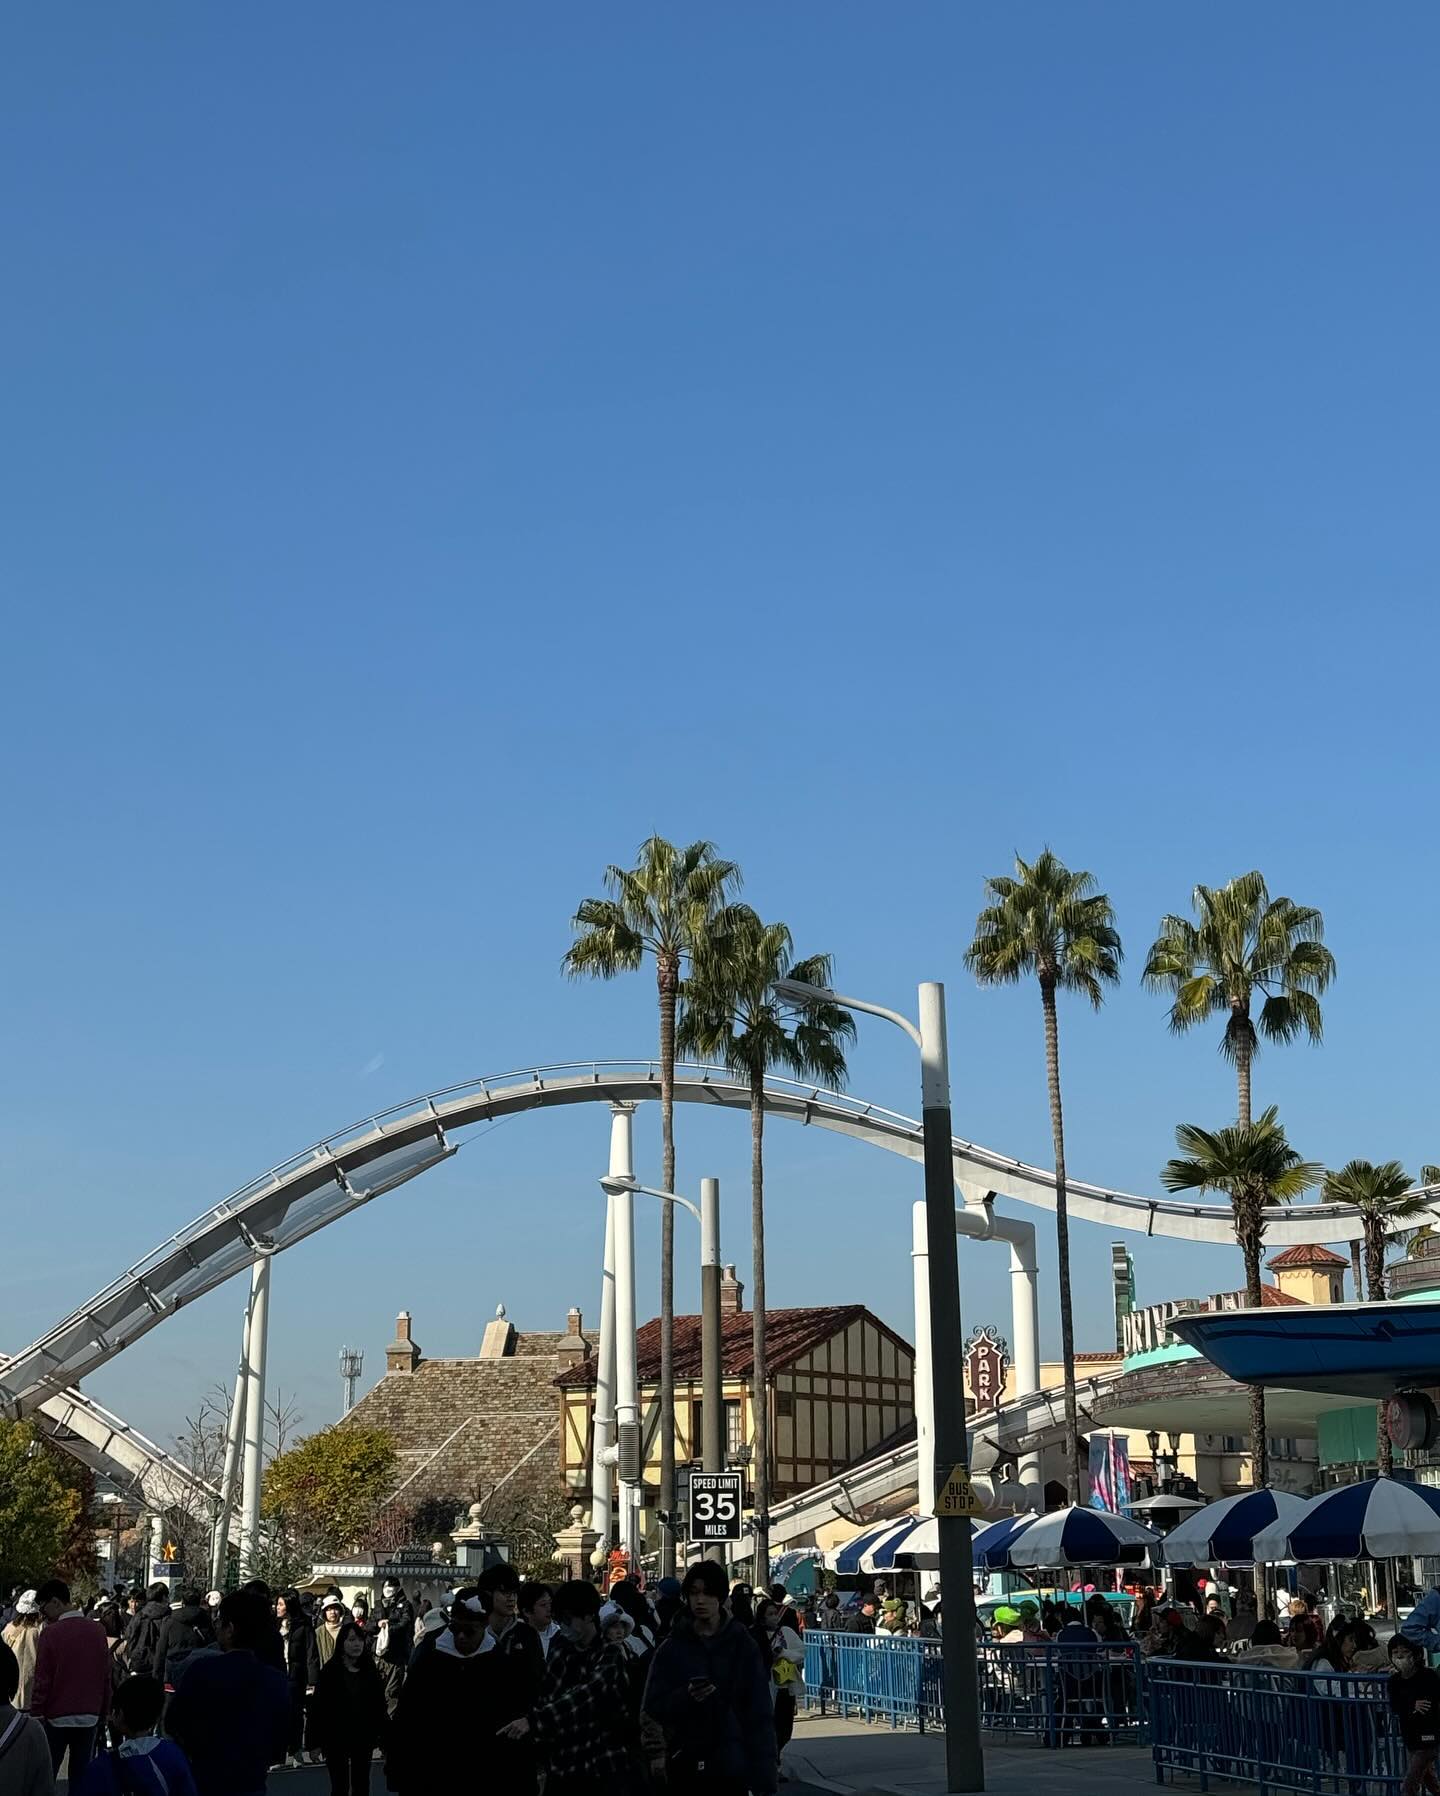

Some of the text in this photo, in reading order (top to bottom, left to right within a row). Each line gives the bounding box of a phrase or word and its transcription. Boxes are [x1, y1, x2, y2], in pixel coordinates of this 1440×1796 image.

[978, 1346, 991, 1401] PARK
[693, 1478, 738, 1489] SPEED LIMIT
[949, 1482, 969, 1496] BUS
[695, 1493, 736, 1521] 35
[944, 1496, 974, 1509] STOP
[704, 1524, 728, 1536] MILES
